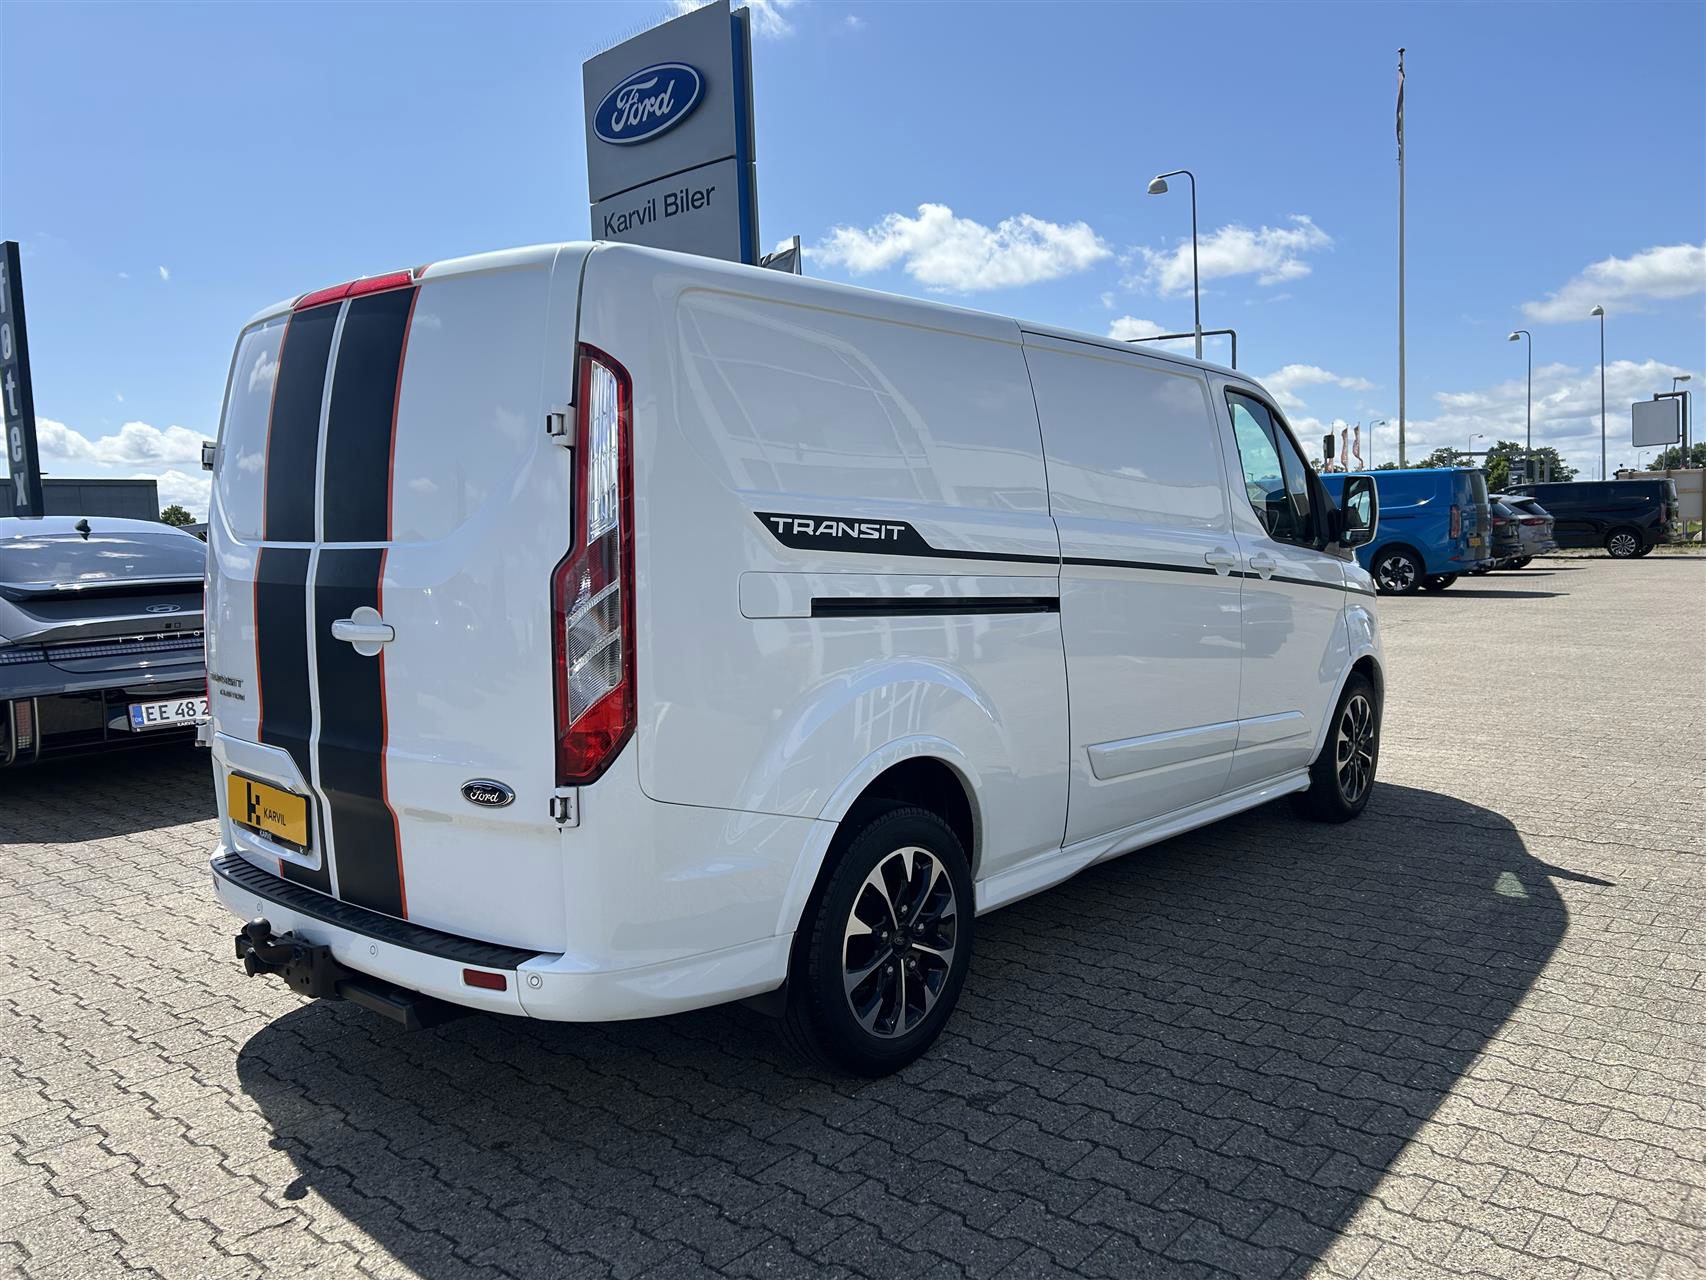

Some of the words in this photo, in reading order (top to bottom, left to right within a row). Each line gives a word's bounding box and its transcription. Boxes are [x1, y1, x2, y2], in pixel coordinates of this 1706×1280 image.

[610, 75, 677, 133] Ford
[603, 198, 657, 238] Karvil
[663, 185, 716, 218] Biler
[769, 516, 906, 541] TRANSIT
[145, 704, 170, 722] EE
[175, 701, 197, 718] 48
[469, 785, 500, 802] Ford
[263, 807, 287, 827] KARVIL
